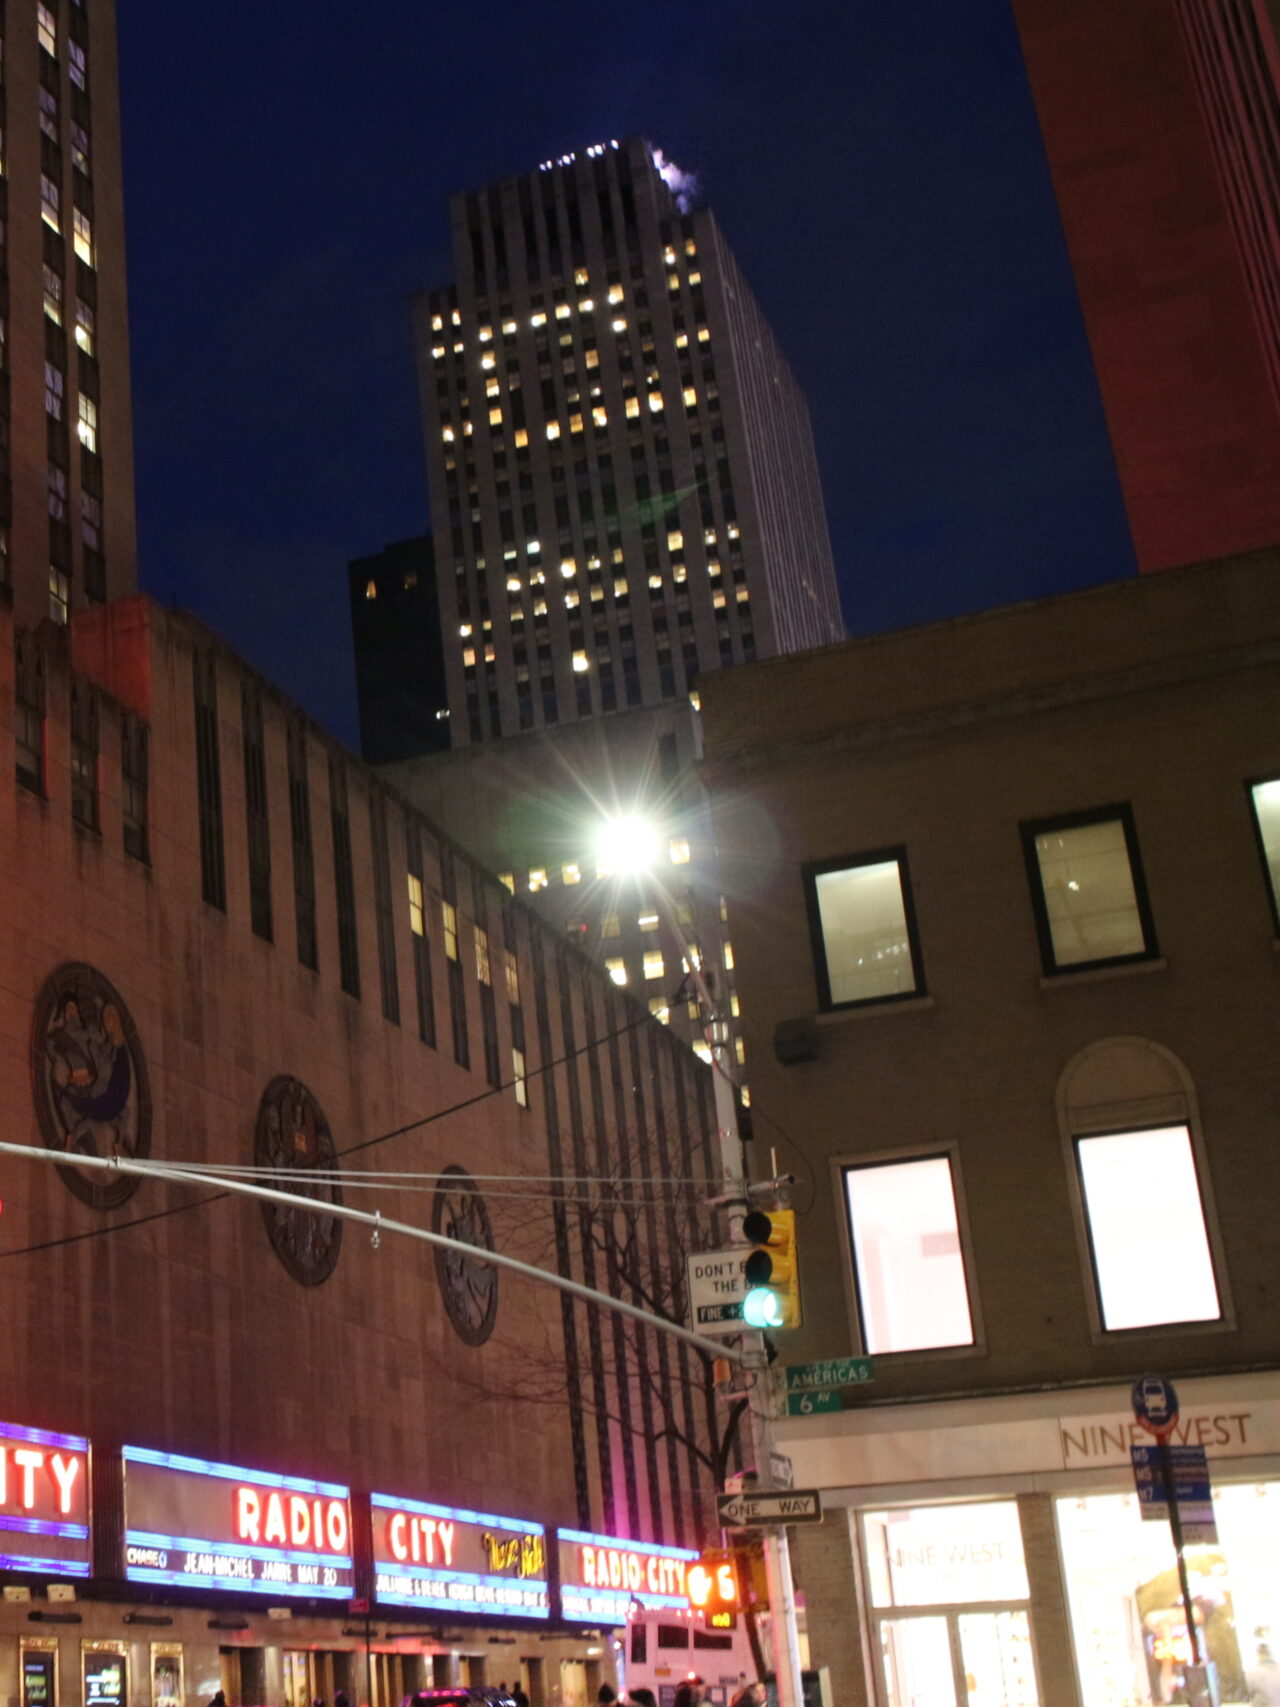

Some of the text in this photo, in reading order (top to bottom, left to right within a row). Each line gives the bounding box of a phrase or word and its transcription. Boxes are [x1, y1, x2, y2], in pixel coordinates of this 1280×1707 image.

[695, 1261, 734, 1278] DON'T
[713, 1279, 738, 1293] THE
[792, 1364, 869, 1388] AMERICAS
[800, 1394, 813, 1413] 6
[1061, 1423, 1144, 1458] NINE
[238, 1486, 348, 1551] RADIO
[728, 1498, 810, 1517] ONE WAY
[389, 1513, 455, 1566] CITY
[943, 1542, 1005, 1564] WEST
[297, 1564, 319, 1586] MAY
[323, 1568, 338, 1587] 20
[582, 1546, 686, 1595] RADIO CITY
